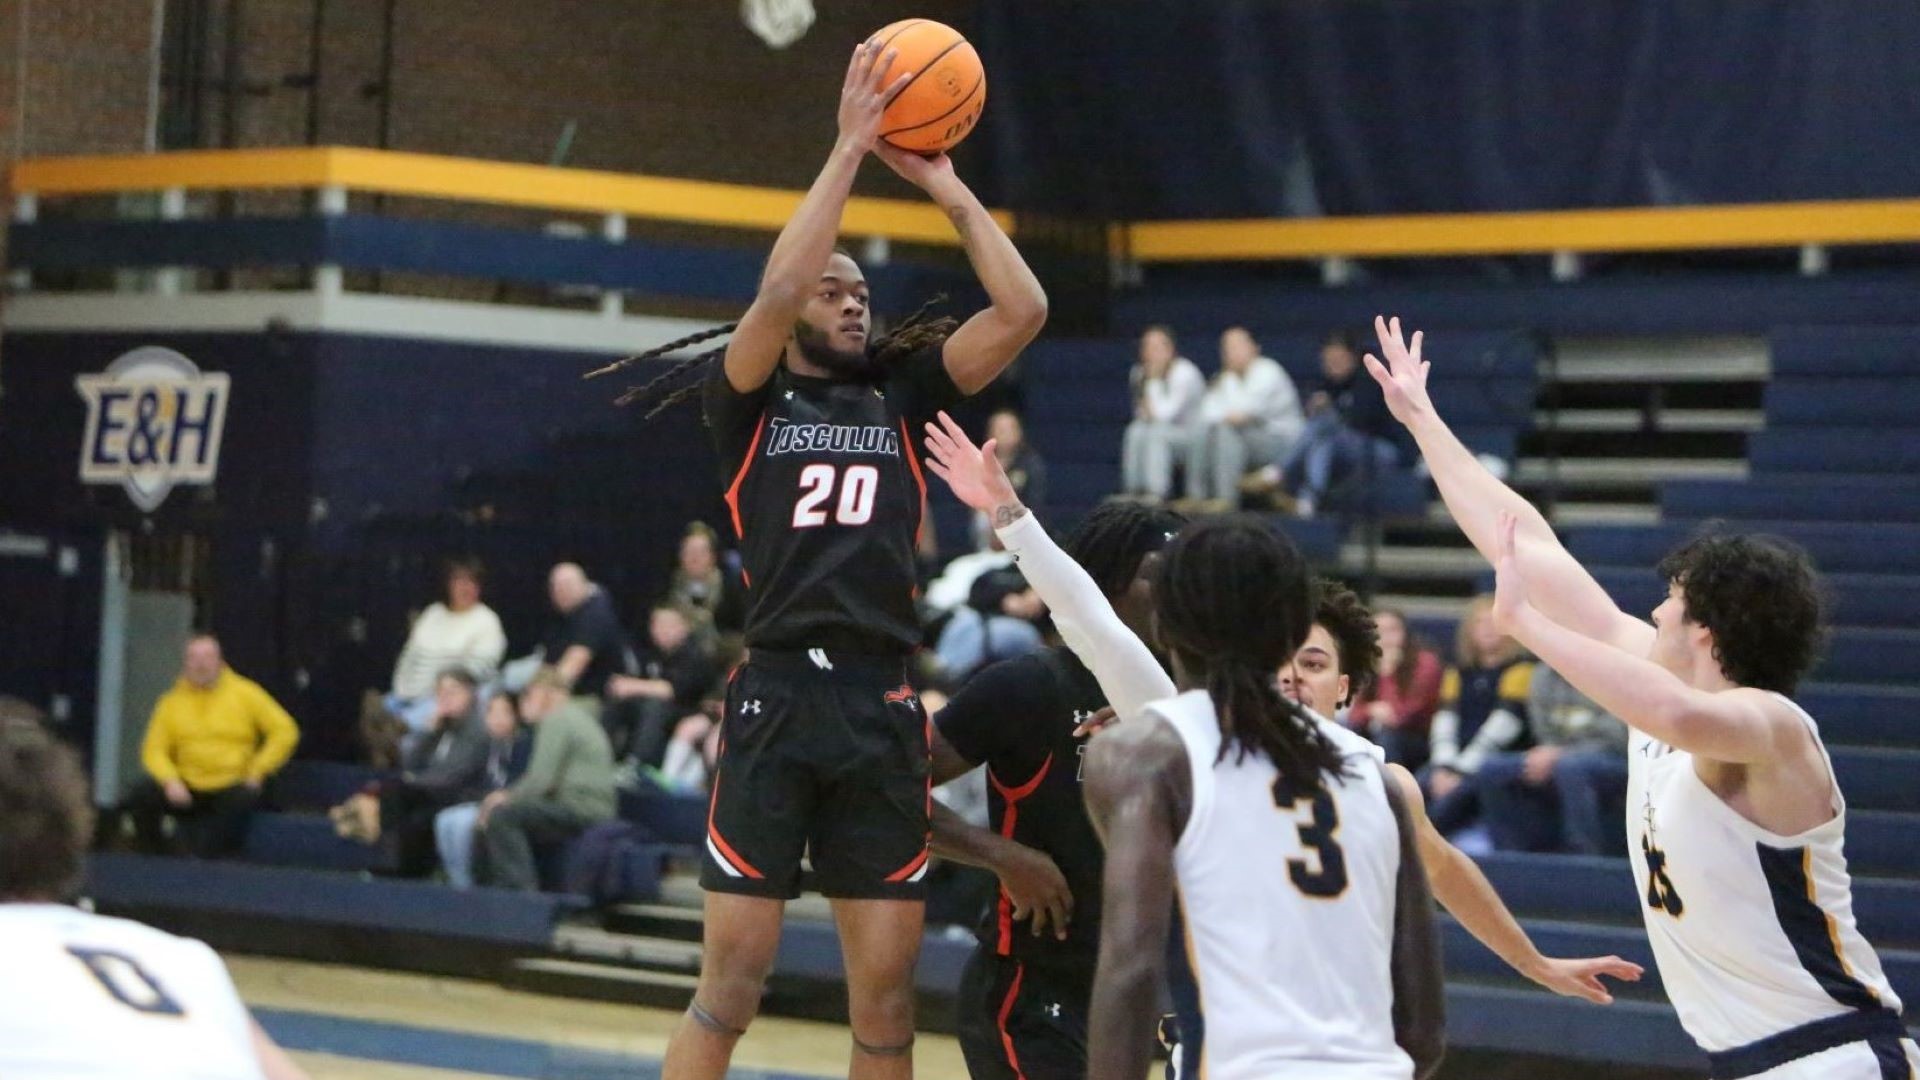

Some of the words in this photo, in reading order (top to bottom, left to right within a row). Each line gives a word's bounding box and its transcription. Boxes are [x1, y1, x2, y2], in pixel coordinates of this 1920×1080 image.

[92, 387, 215, 466] E&H
[791, 462, 879, 529] 20
[1269, 770, 1350, 899] 3
[64, 945, 187, 1016] 0
